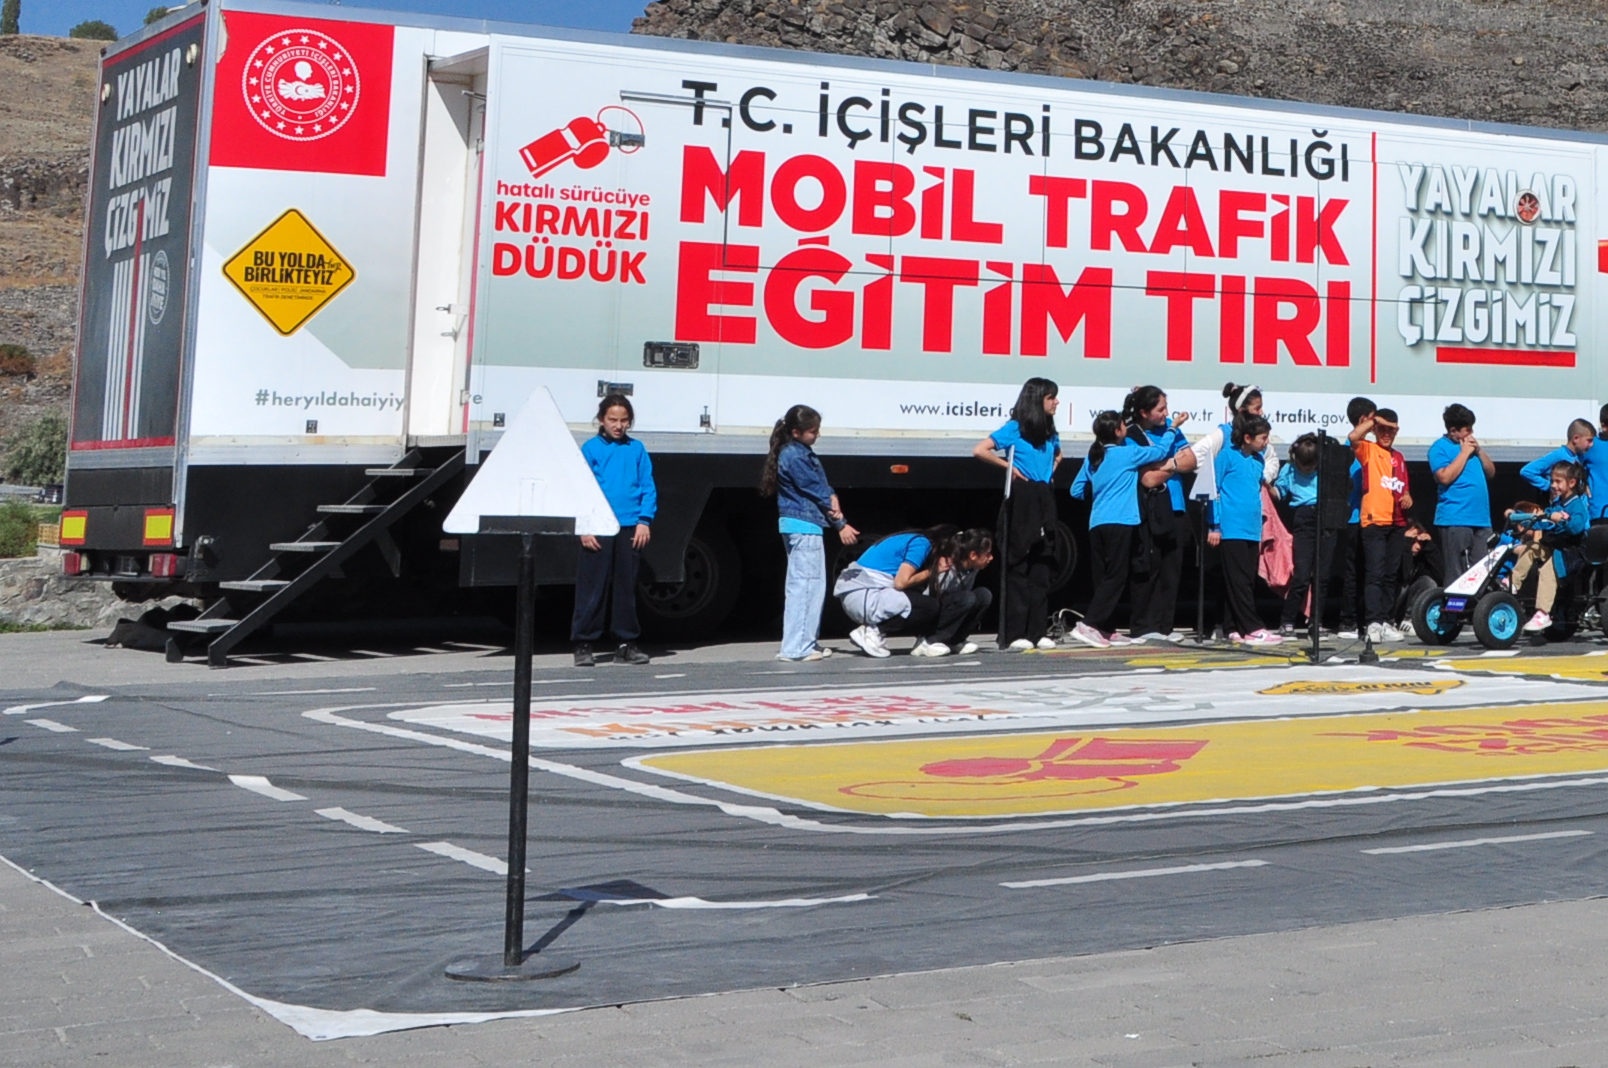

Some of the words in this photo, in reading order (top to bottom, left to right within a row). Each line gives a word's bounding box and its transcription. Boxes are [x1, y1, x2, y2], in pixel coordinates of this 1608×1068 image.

[116, 47, 182, 122] YAYALAR
[109, 105, 178, 190] KIRMIZI
[682, 79, 793, 135] T.C.
[818, 81, 1052, 156] İÇİŞLERİ
[1073, 118, 1350, 183] BAKANLIĞI
[104, 177, 173, 260] ÇİZGİMİZ
[494, 200, 650, 241] KIRMIZI
[496, 180, 555, 200] hatalı
[559, 184, 651, 209] sürücüye
[680, 144, 1004, 245] MOBİL
[1029, 174, 1351, 267] TRAFİK
[1397, 161, 1578, 223] YAYALAR
[243, 266, 334, 286] BİRLİKTEYİZ
[253, 250, 275, 267] BU
[278, 251, 326, 270] YOLDA
[492, 235, 648, 285] DÜDÜK
[1398, 216, 1577, 287] KIRMIZI
[673, 235, 1114, 360] EĞİTİM
[1145, 269, 1351, 368] TIRI
[1397, 285, 1578, 349] ÇİZGİMİZ
